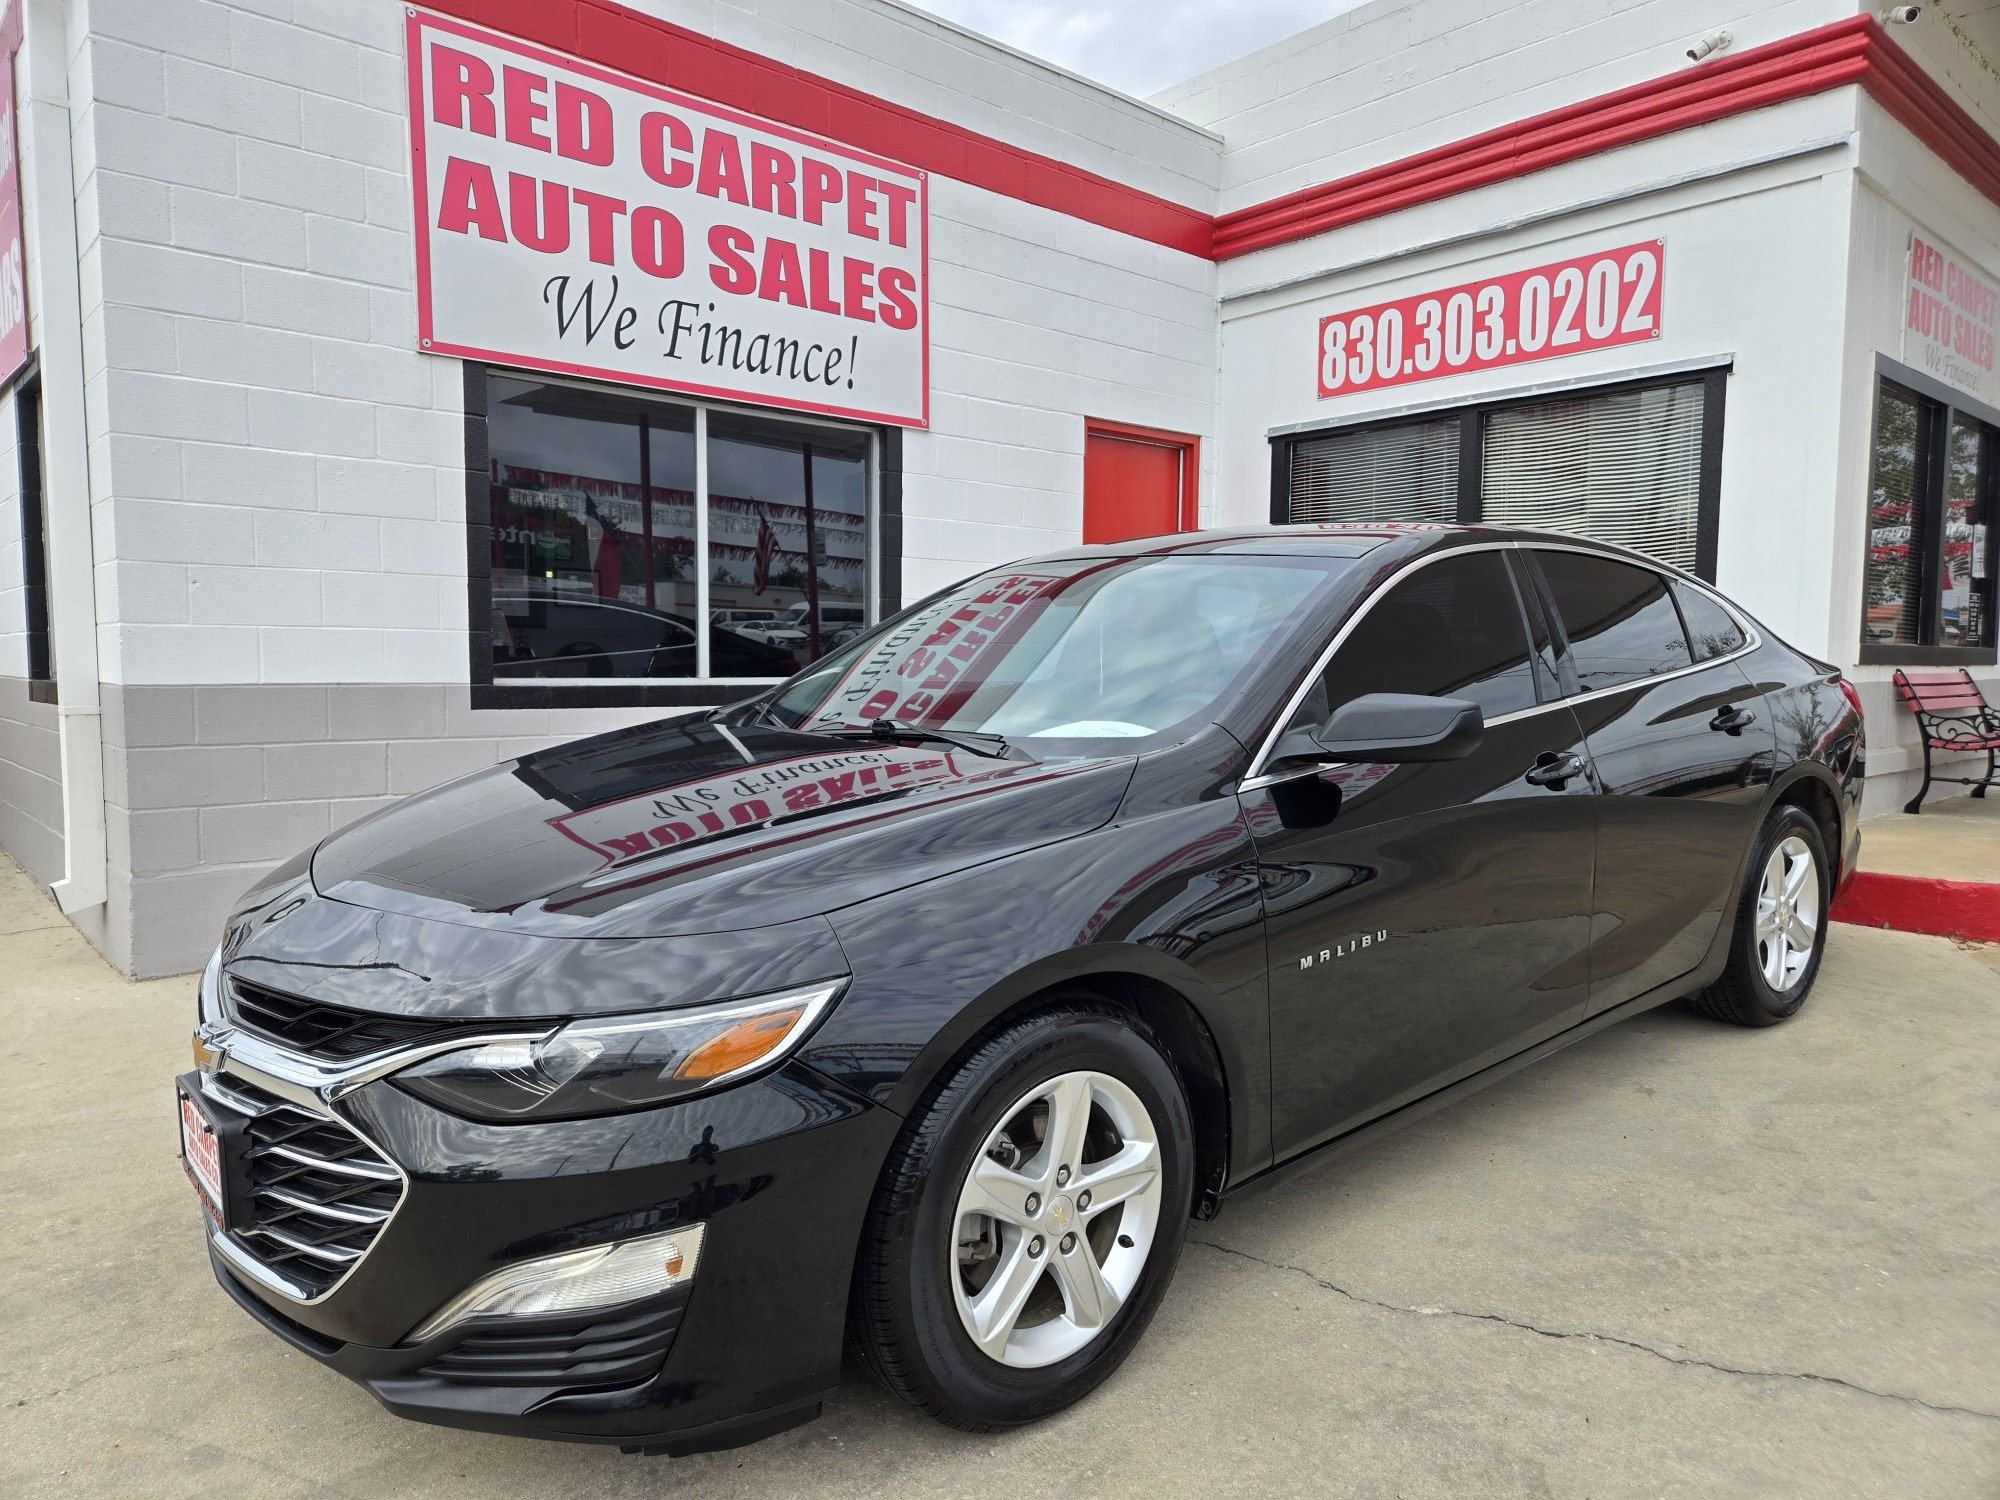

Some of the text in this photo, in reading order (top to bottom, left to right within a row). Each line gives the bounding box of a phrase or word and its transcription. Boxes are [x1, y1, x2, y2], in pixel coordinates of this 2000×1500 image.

[430, 42, 916, 249] RED CARPET
[437, 155, 918, 331] AUTO SALES
[1910, 237, 1999, 328] RED CARPET
[543, 274, 858, 390] We Finance!
[1322, 250, 1657, 390] 830.303.0202
[1908, 287, 1994, 372] AUTO SALES
[1924, 344, 1981, 392] We Finance!
[1299, 929, 1387, 971] MALIBU
